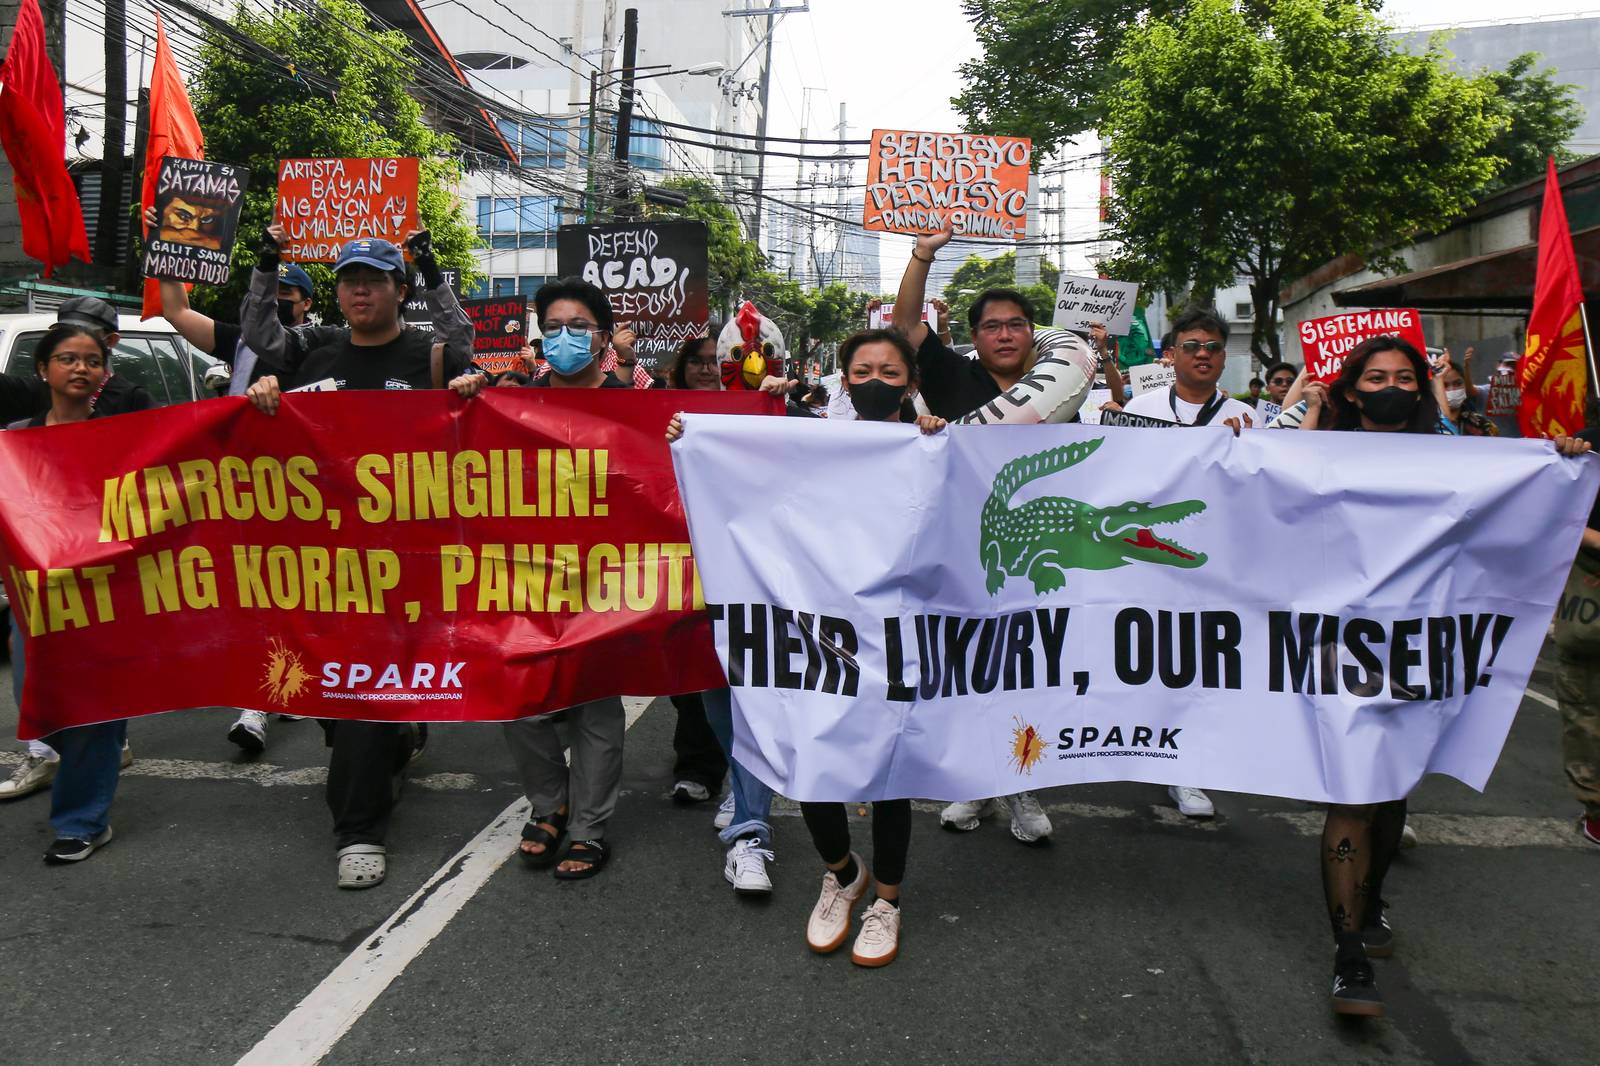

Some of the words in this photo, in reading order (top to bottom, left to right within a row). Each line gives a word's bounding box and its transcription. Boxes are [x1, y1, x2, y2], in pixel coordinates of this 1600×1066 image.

[880, 132, 1030, 169] SERBISYO
[173, 159, 213, 173] KAHIT
[221, 166, 235, 176] SI
[281, 160, 346, 181] ARTISTA
[370, 160, 398, 178] NG
[880, 158, 1001, 185] HINDI
[158, 165, 241, 204] SATANAS
[311, 177, 382, 199] BAYAN
[281, 196, 370, 221] NGAYON
[382, 195, 407, 214] AY
[867, 180, 1027, 217] PERWISYO
[281, 215, 406, 240] UMALABAN!
[152, 240, 192, 256] GALIT
[197, 249, 227, 264] SAYO
[588, 229, 659, 260] DEFEND
[144, 251, 197, 280] MARCOS
[582, 255, 678, 290] ACAD
[606, 267, 690, 319] EEDOM!
[1063, 280, 1089, 295] Their
[1058, 299, 1080, 311] our
[1080, 300, 1127, 321] misery!
[1301, 311, 1412, 345] SISTEMANG
[98, 455, 341, 544] MARCOS,
[355, 448, 609, 524] SINGILIN!
[136, 545, 220, 615] NG
[232, 544, 421, 623] KORAP,
[1113, 606, 1242, 690] OUR
[1267, 609, 1516, 701] MISERY!
[320, 661, 467, 689] SPARK
[322, 691, 356, 700] SAMAHAN
[357, 692, 368, 701] NG
[368, 692, 426, 701] PROGRESIBONG
[426, 692, 463, 701] KABATAAN
[1057, 725, 1183, 750] SPARK
[1058, 752, 1087, 761] SAMAHAN
[1096, 750, 1145, 758] PROGRESIBONG
[1145, 751, 1178, 760] KABATAAN
